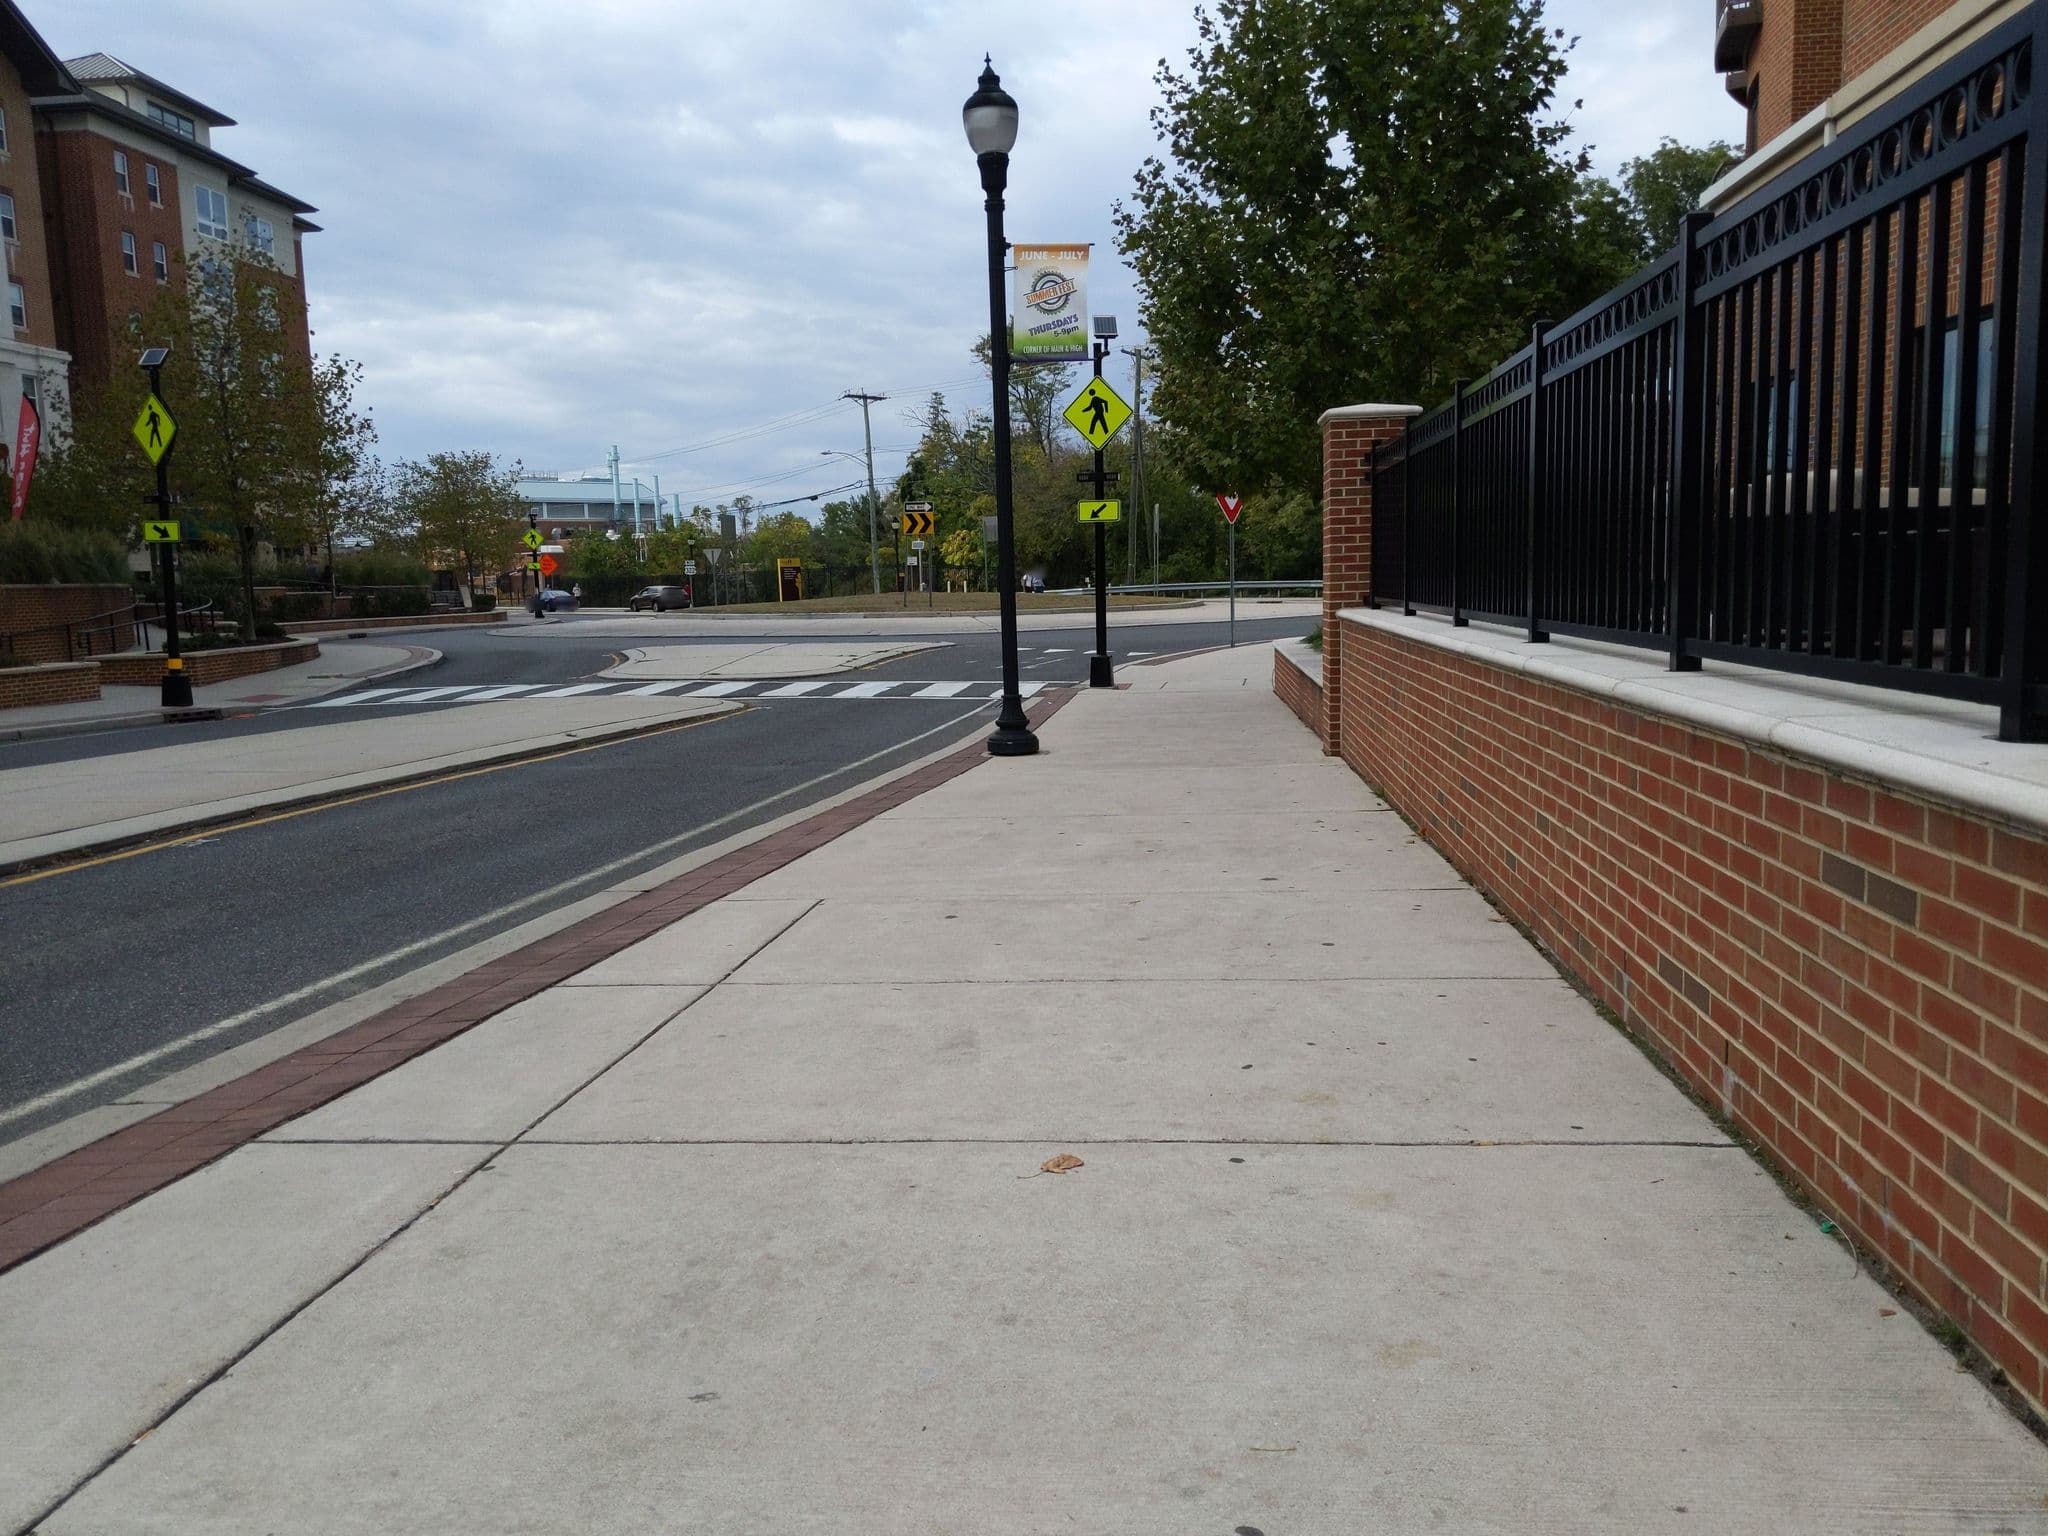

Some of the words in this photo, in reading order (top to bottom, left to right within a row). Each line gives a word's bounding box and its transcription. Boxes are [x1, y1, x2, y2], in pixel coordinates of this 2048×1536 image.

[1020, 251, 1048, 260] JUNE
[1058, 251, 1084, 260] JULY
[1026, 286, 1058, 304] SUMMER
[1059, 280, 1075, 295] FEST
[1028, 315, 1078, 336] THURSDAYS
[1054, 326, 1079, 337] 5-9pm
